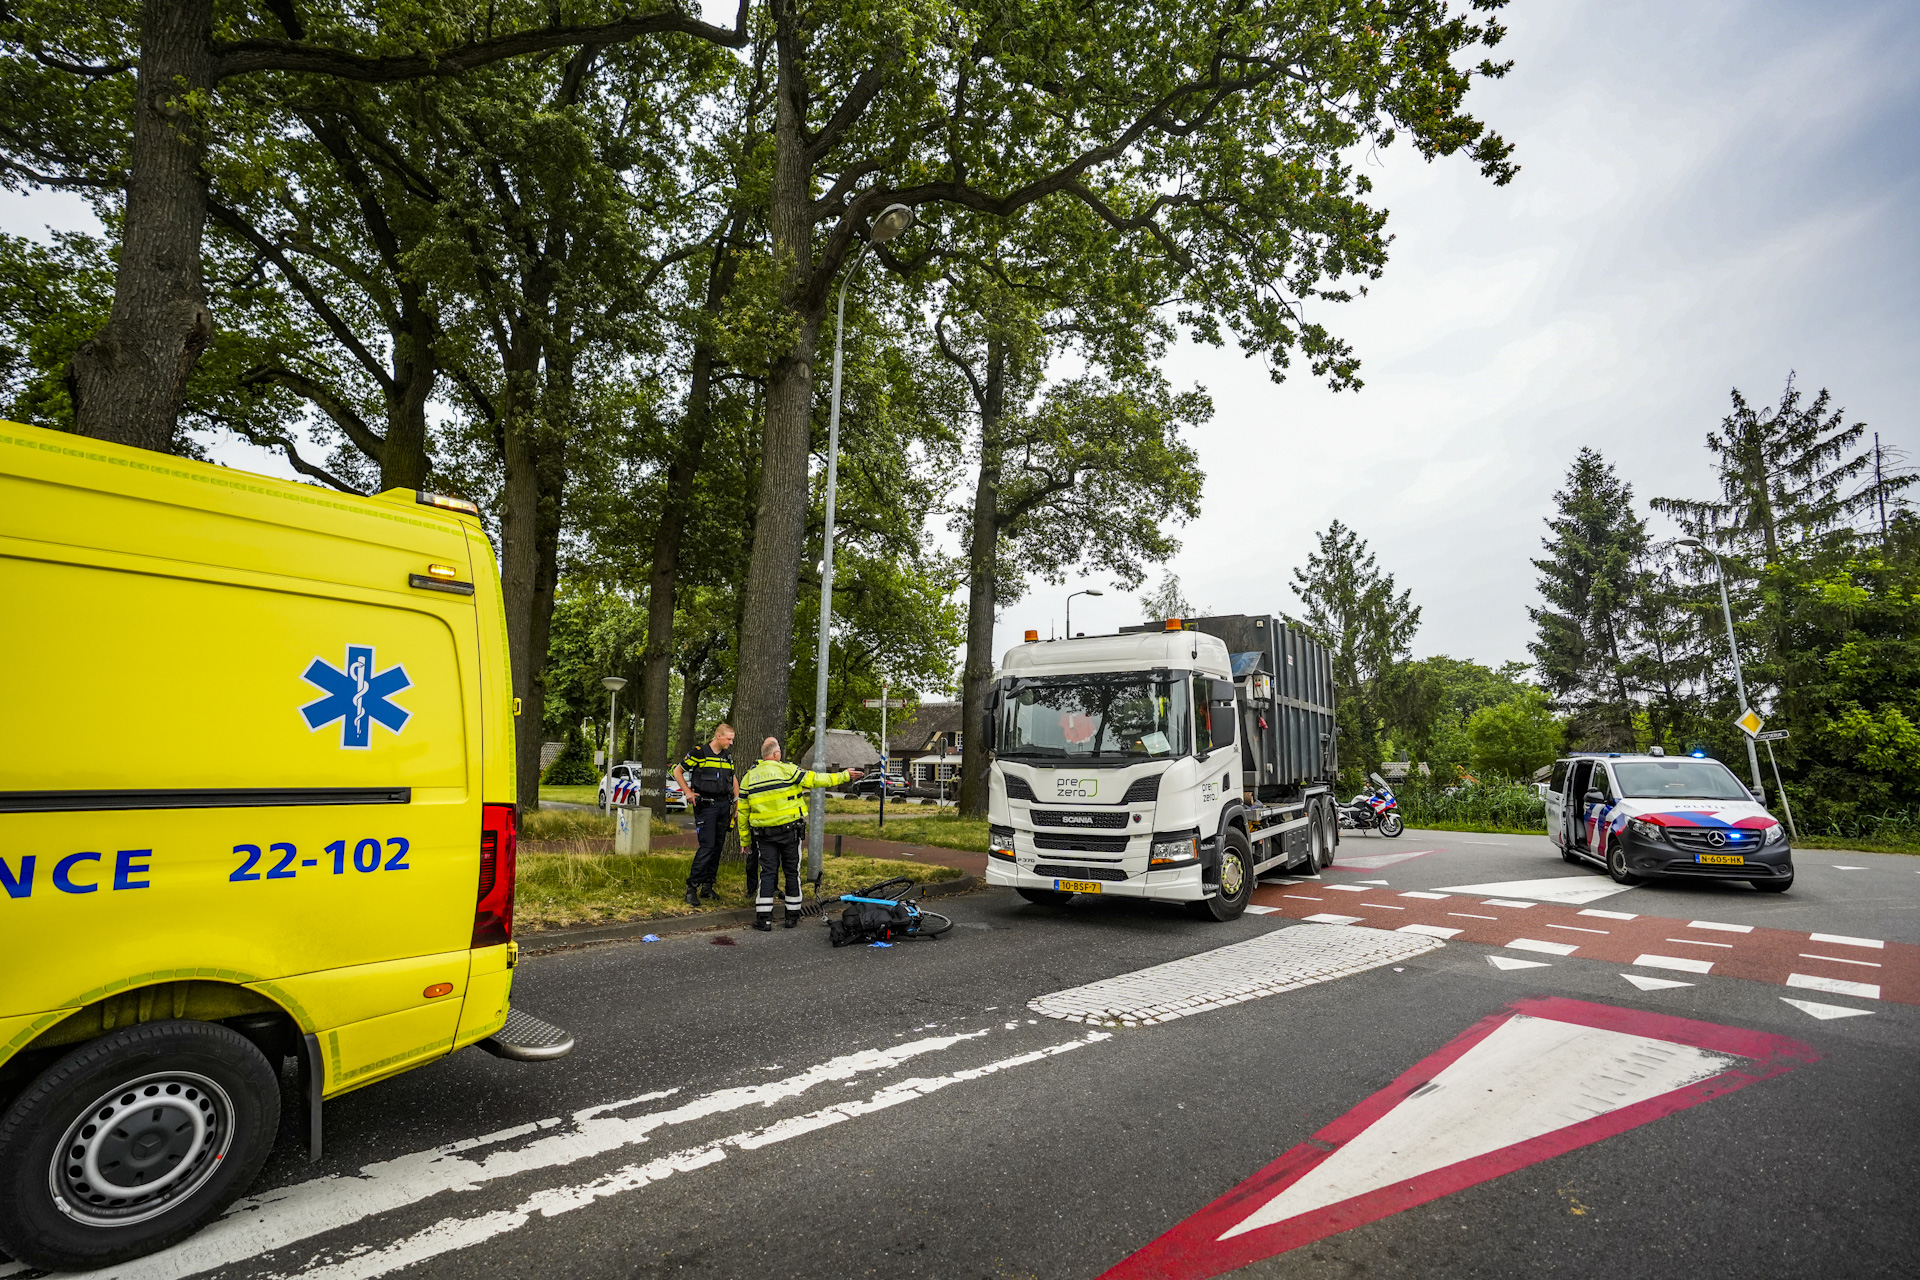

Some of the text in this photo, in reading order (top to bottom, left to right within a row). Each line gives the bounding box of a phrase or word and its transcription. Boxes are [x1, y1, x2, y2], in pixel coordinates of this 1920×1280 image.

[1057, 778, 1078, 788] pre
[1057, 789, 1086, 797] zero
[1203, 793, 1215, 802] zero
[1062, 816, 1093, 824] SCANIA
[228, 837, 411, 883] 22-102
[1701, 855, 1742, 864] N-605-HK
[1062, 881, 1096, 891] 10-BSF-7
